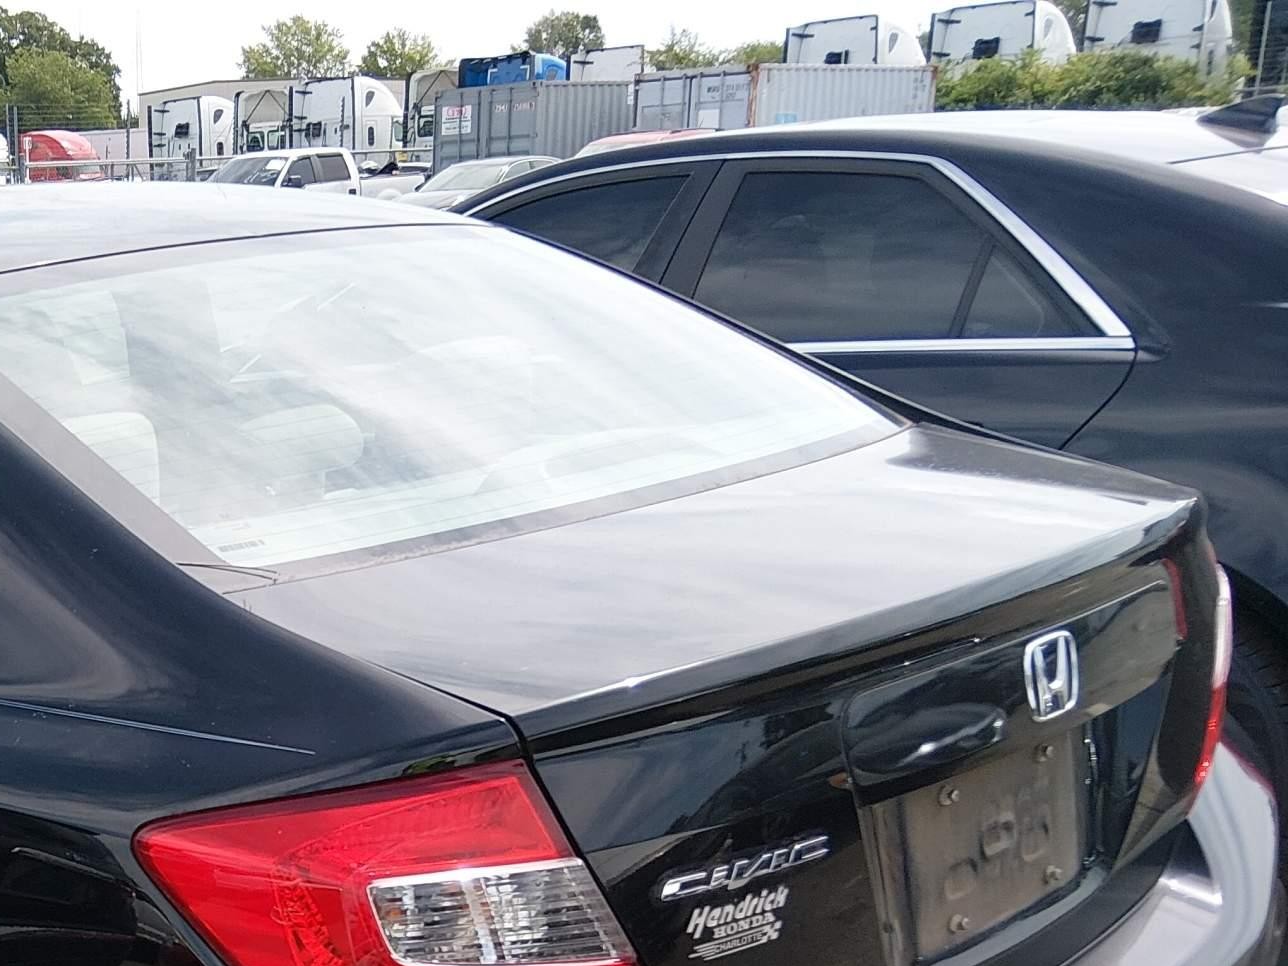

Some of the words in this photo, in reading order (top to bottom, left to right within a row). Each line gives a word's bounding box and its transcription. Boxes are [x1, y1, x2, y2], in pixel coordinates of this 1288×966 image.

[660, 834, 830, 902] CIVIC
[685, 884, 791, 940] Hendrick
[712, 911, 777, 939] HONDA
[713, 931, 764, 953] CHARLOTTE
